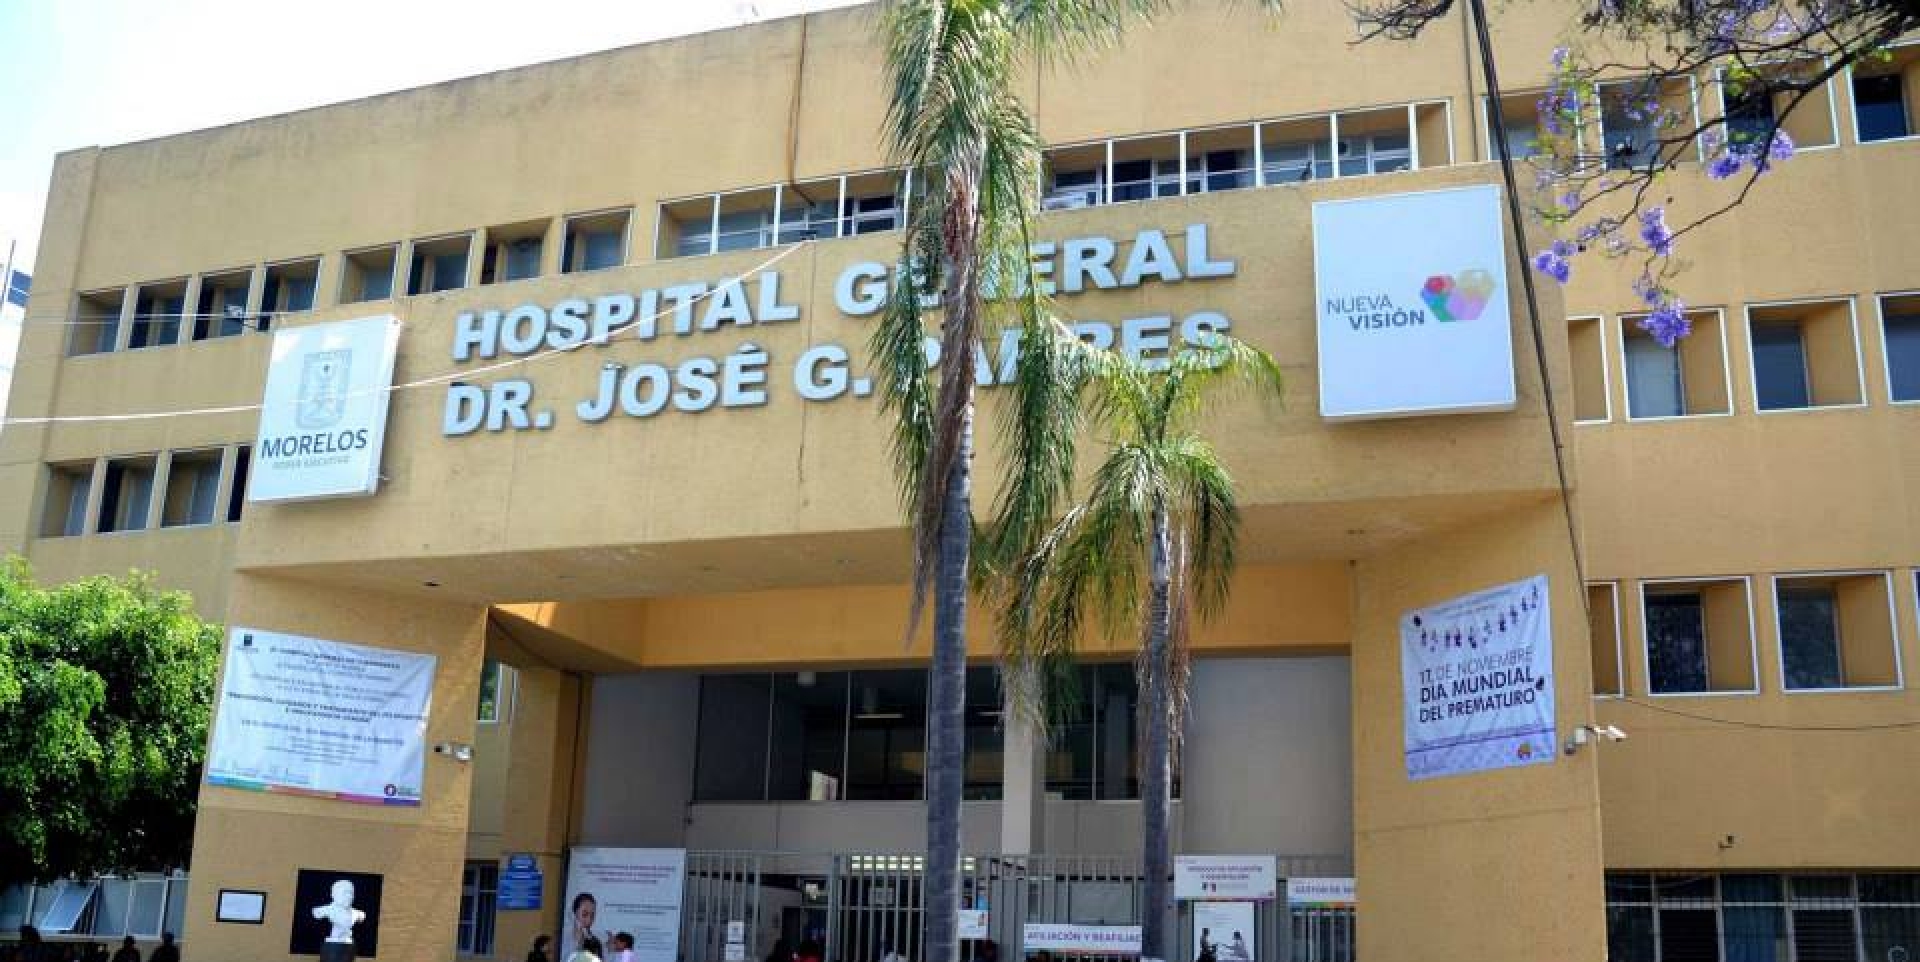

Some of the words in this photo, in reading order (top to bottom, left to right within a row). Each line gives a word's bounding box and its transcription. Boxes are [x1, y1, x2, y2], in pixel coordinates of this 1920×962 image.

[452, 271, 800, 361] HOSPITAL
[1327, 293, 1392, 315] NUEVA
[1348, 307, 1425, 331] VISIÓN
[442, 380, 554, 437] DR.
[576, 342, 769, 423] JOSÉ
[793, 344, 873, 401] G.
[898, 312, 1233, 392] RES
[261, 428, 368, 459] MORELOS
[1436, 664, 1453, 681] DE
[1452, 666, 1535, 697] MUNDIAL
[1419, 707, 1444, 723] DEL
[1447, 687, 1535, 719] PREMATURO
